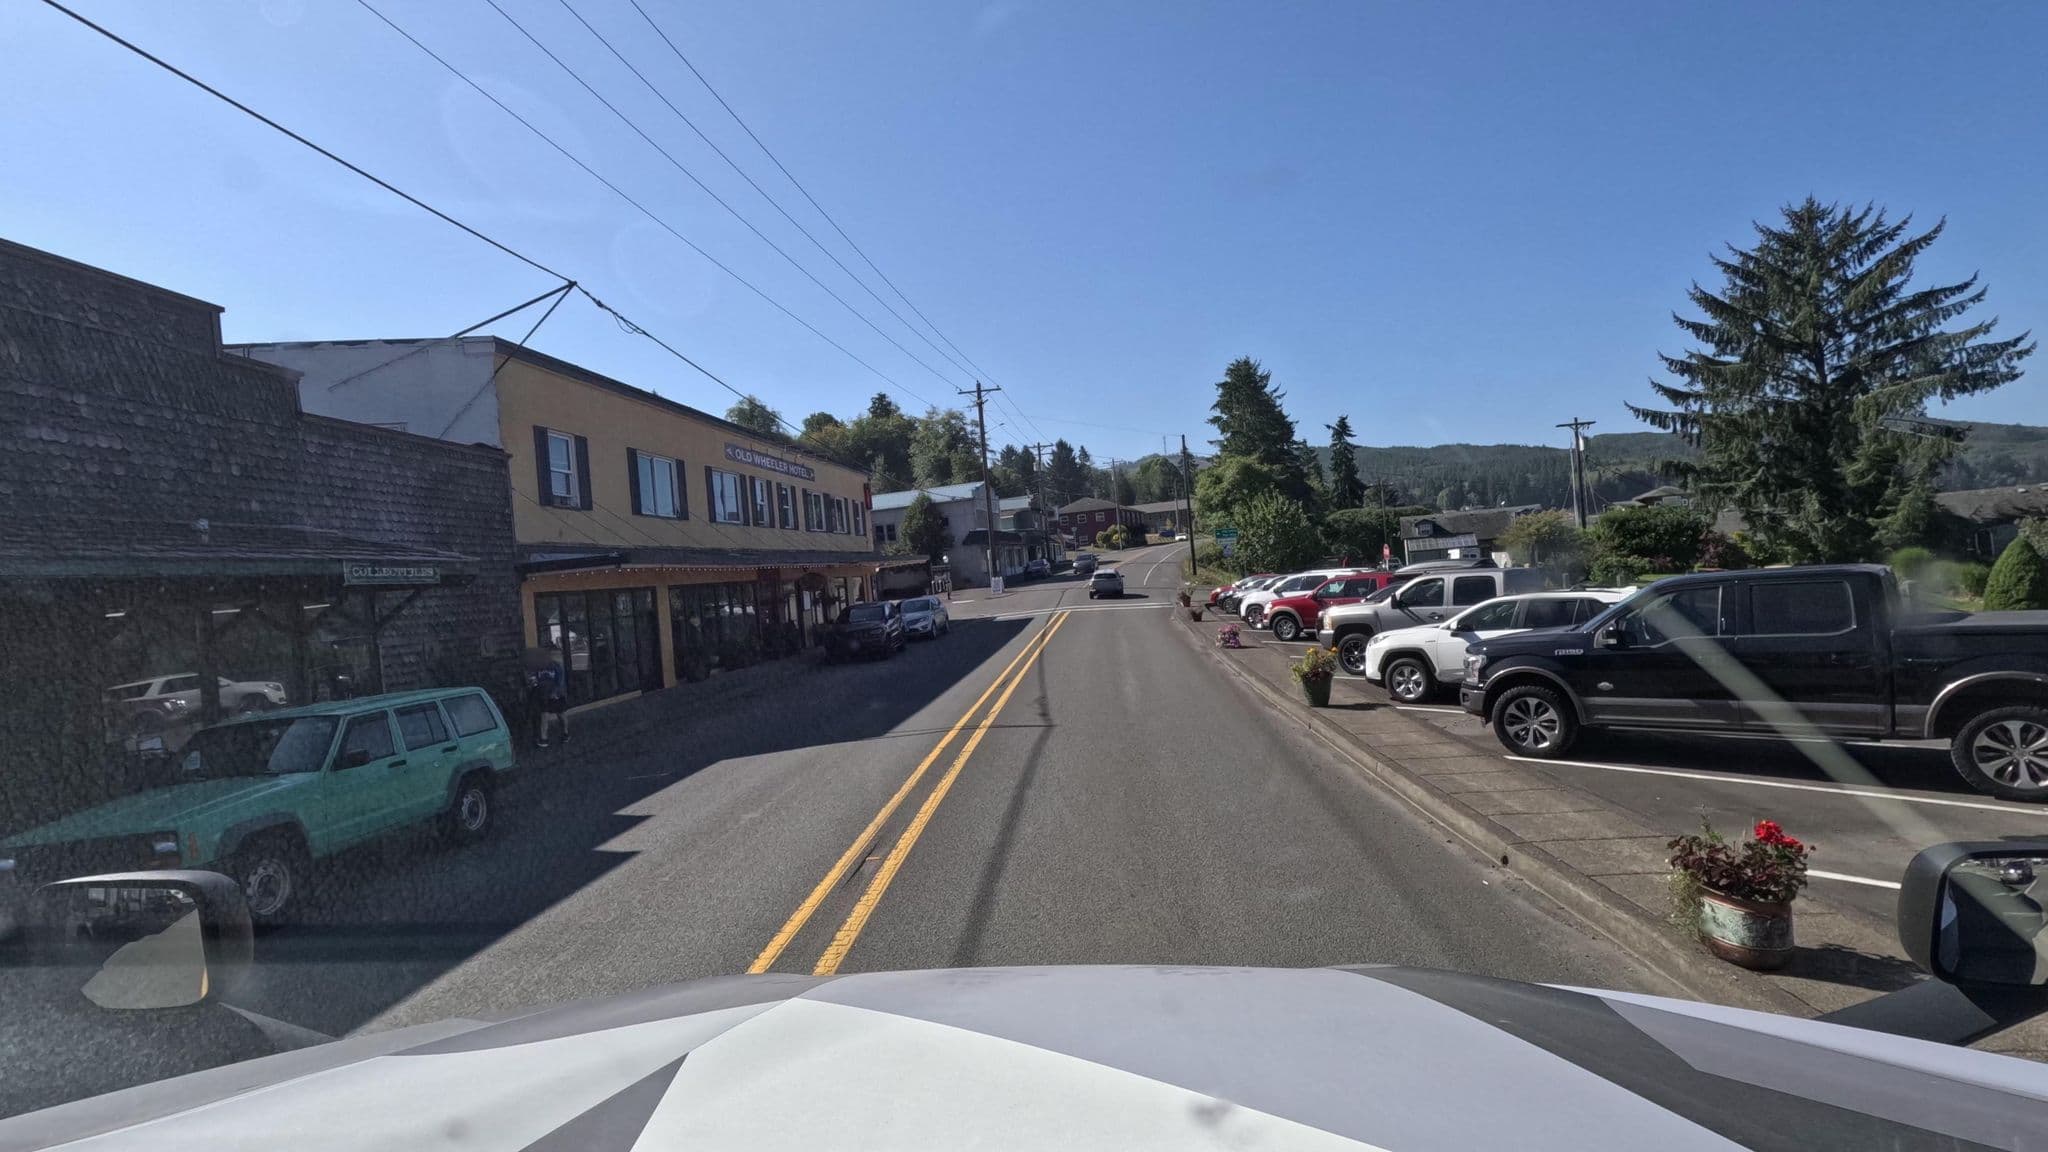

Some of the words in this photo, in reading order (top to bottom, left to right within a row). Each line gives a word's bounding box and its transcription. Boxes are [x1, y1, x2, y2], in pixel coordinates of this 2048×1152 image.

[735, 448, 752, 462] OLD
[753, 454, 788, 473] WHEELER
[789, 464, 809, 477] HOTEL
[352, 567, 434, 577] COLLECTIBLES
